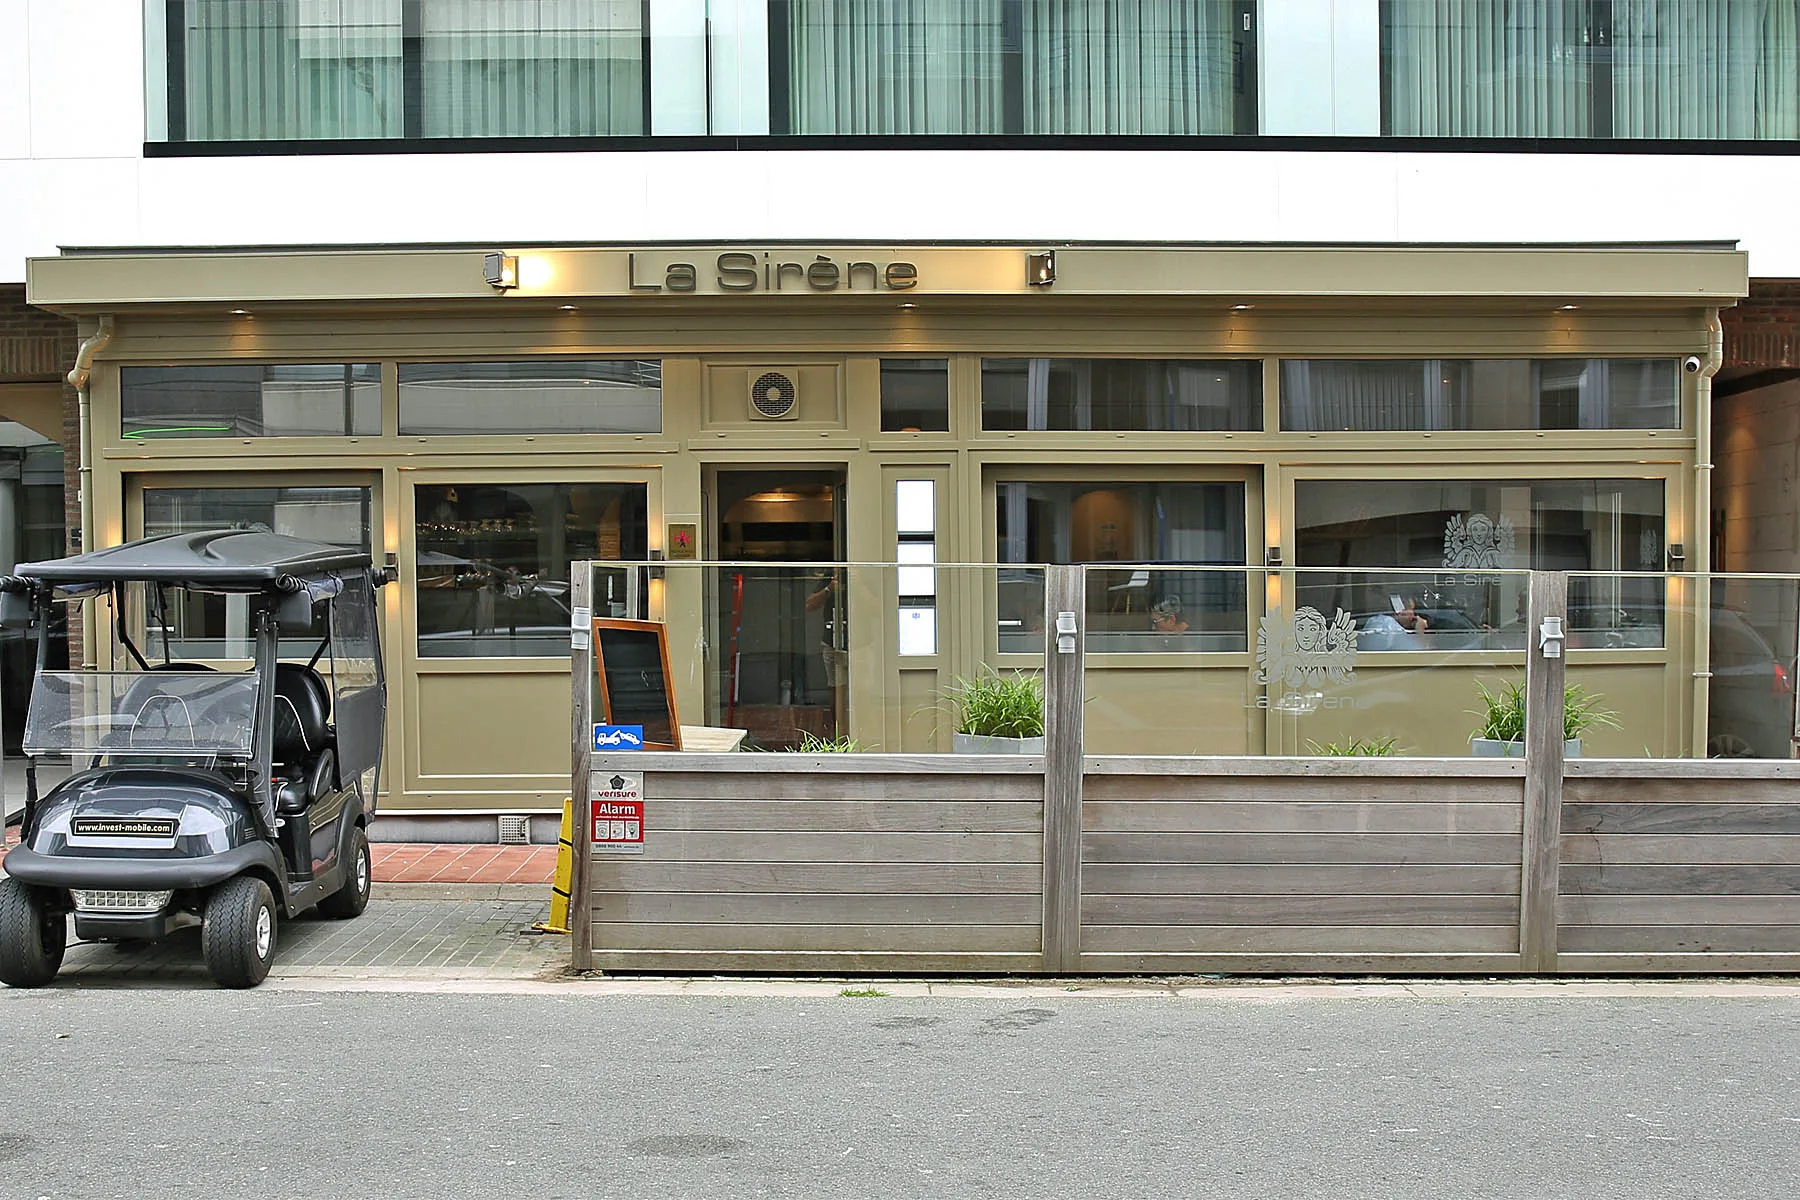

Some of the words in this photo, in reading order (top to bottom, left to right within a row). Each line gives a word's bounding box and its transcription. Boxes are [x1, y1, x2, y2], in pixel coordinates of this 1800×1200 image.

[628, 252, 697, 291] La
[717, 251, 918, 291] Sirène
[1434, 574, 1456, 586] La
[600, 802, 636, 814] Alarm
[78, 823, 170, 832] www.invest-mobile.com
